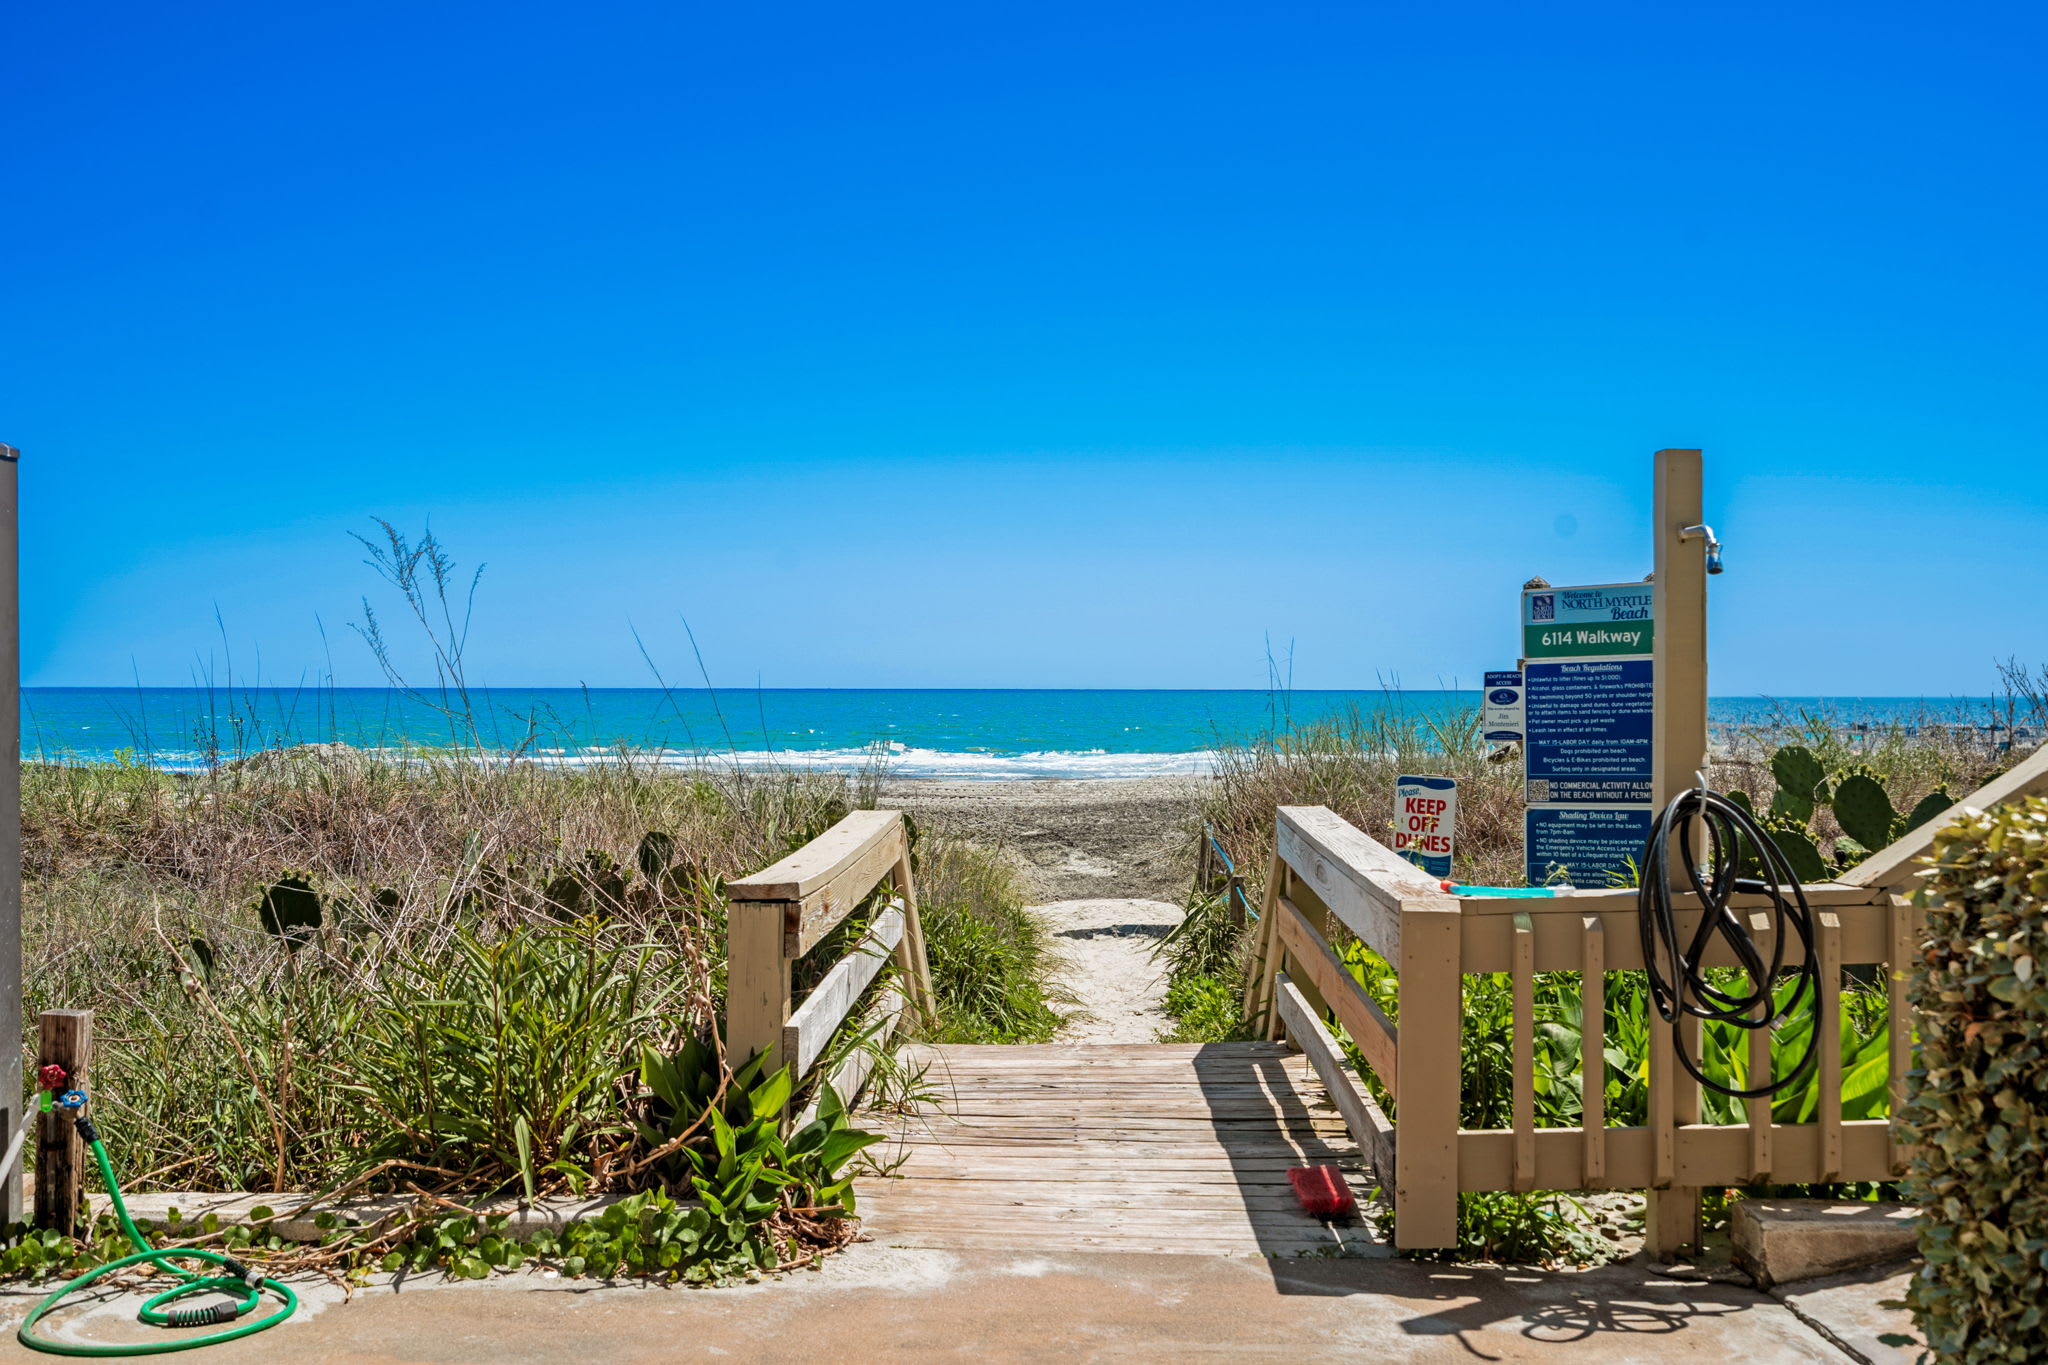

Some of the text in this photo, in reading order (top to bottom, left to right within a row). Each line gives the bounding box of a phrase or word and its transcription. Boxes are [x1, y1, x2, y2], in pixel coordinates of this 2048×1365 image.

[1562, 595, 1652, 609] NORTH MYRTLE
[1611, 606, 1648, 620] Beach
[1542, 630, 1641, 646] 6114 Walkway
[1583, 664, 1623, 672] Regulations
[1398, 788, 1421, 798] Please,
[1406, 797, 1446, 815] KEEP
[1559, 811, 1587, 821] Shading
[1614, 812, 1629, 821] Law
[1408, 816, 1440, 833] OFF
